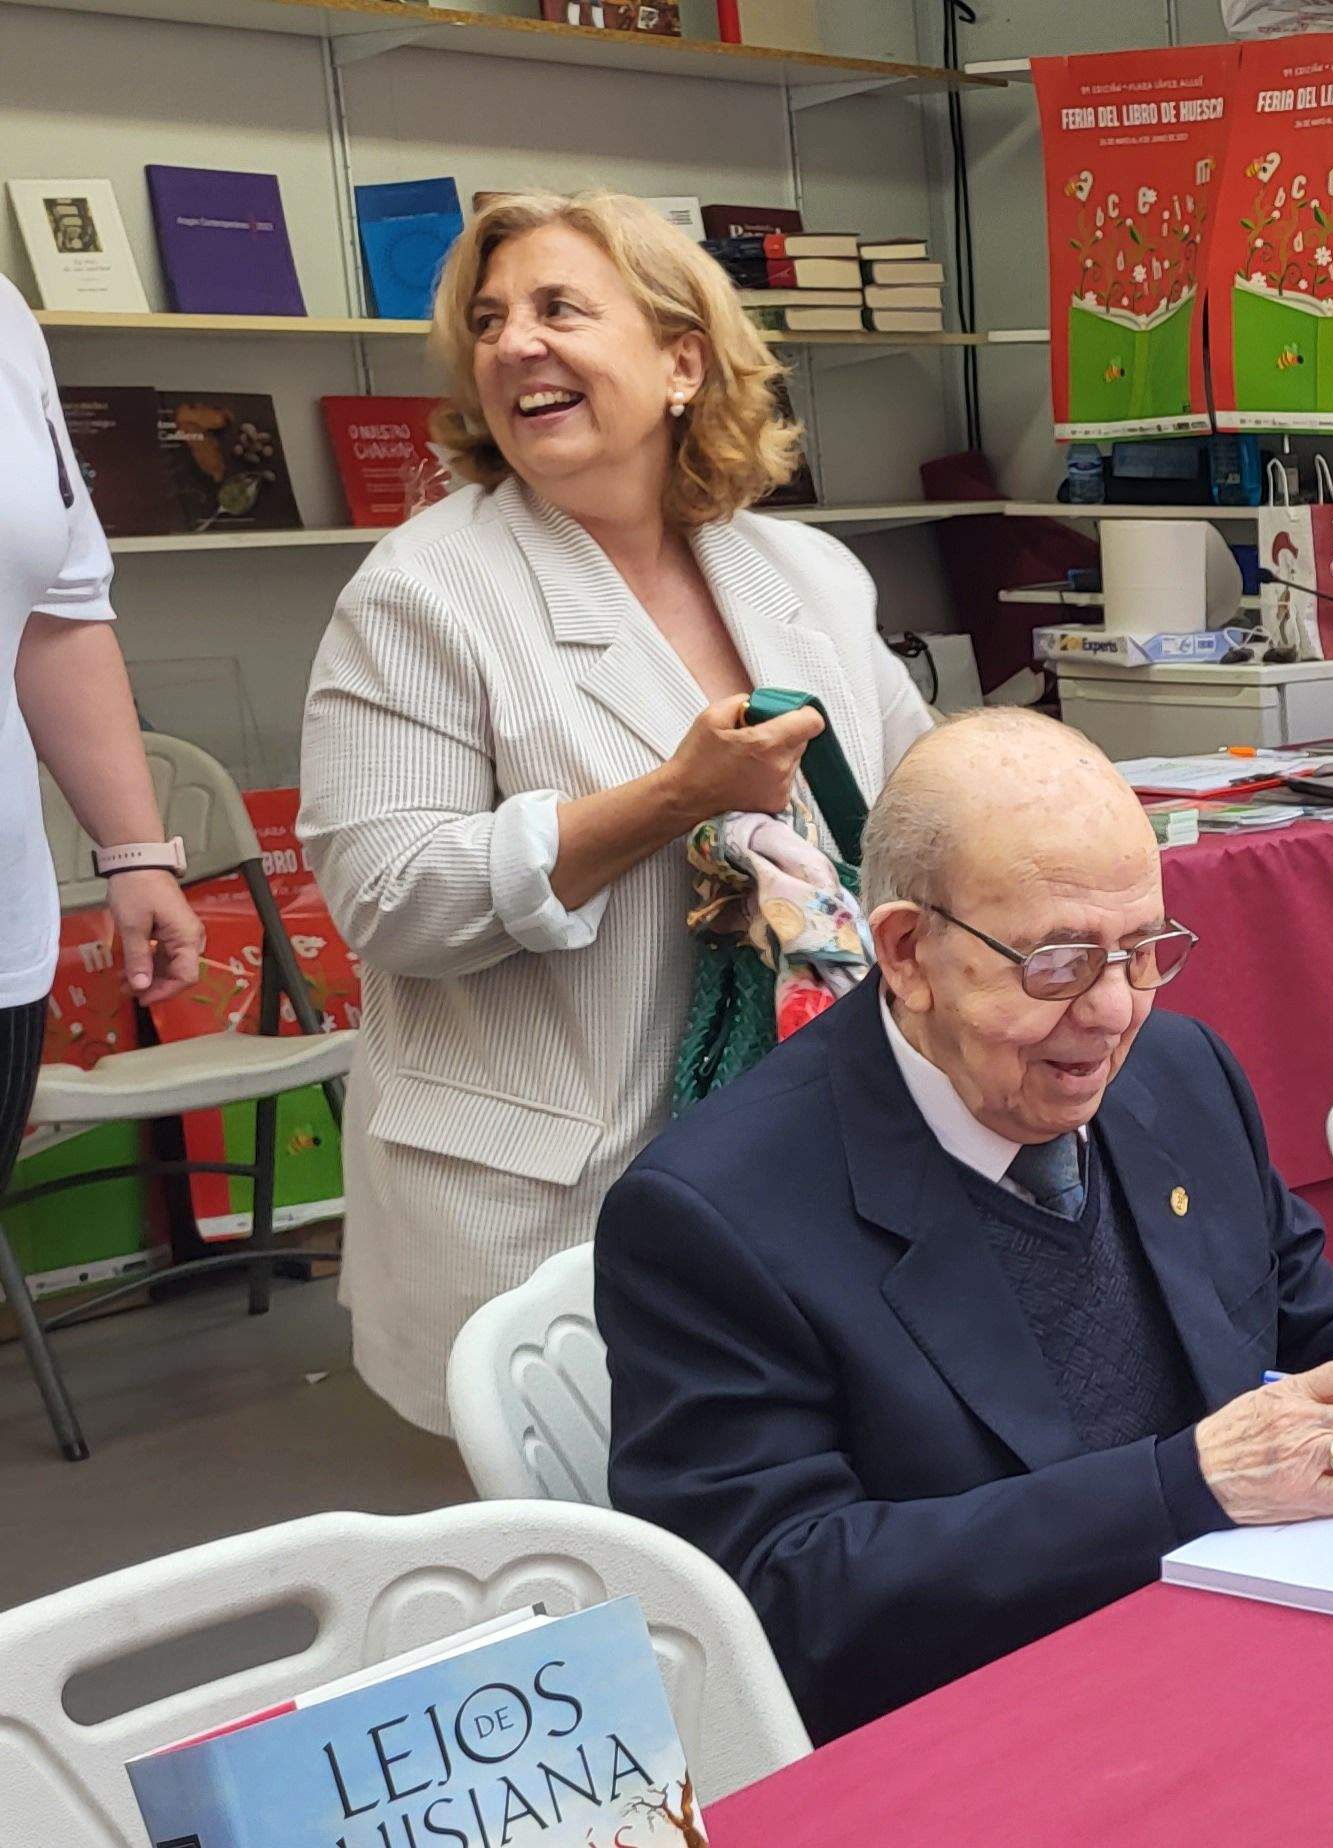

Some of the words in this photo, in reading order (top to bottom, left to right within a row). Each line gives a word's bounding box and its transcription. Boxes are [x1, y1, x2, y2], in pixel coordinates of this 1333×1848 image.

[1061, 106, 1096, 130] FERIA
[1097, 104, 1121, 127] DEL
[1122, 102, 1159, 126] LIBRO
[1160, 101, 1178, 123] DE
[1179, 97, 1225, 122] HUESCA
[1256, 89, 1295, 113] FERIA
[1296, 86, 1318, 110] DEL
[262, 848, 299, 877] BRO
[473, 1706, 515, 1740] DE
[322, 1660, 583, 1820] LEJOS
